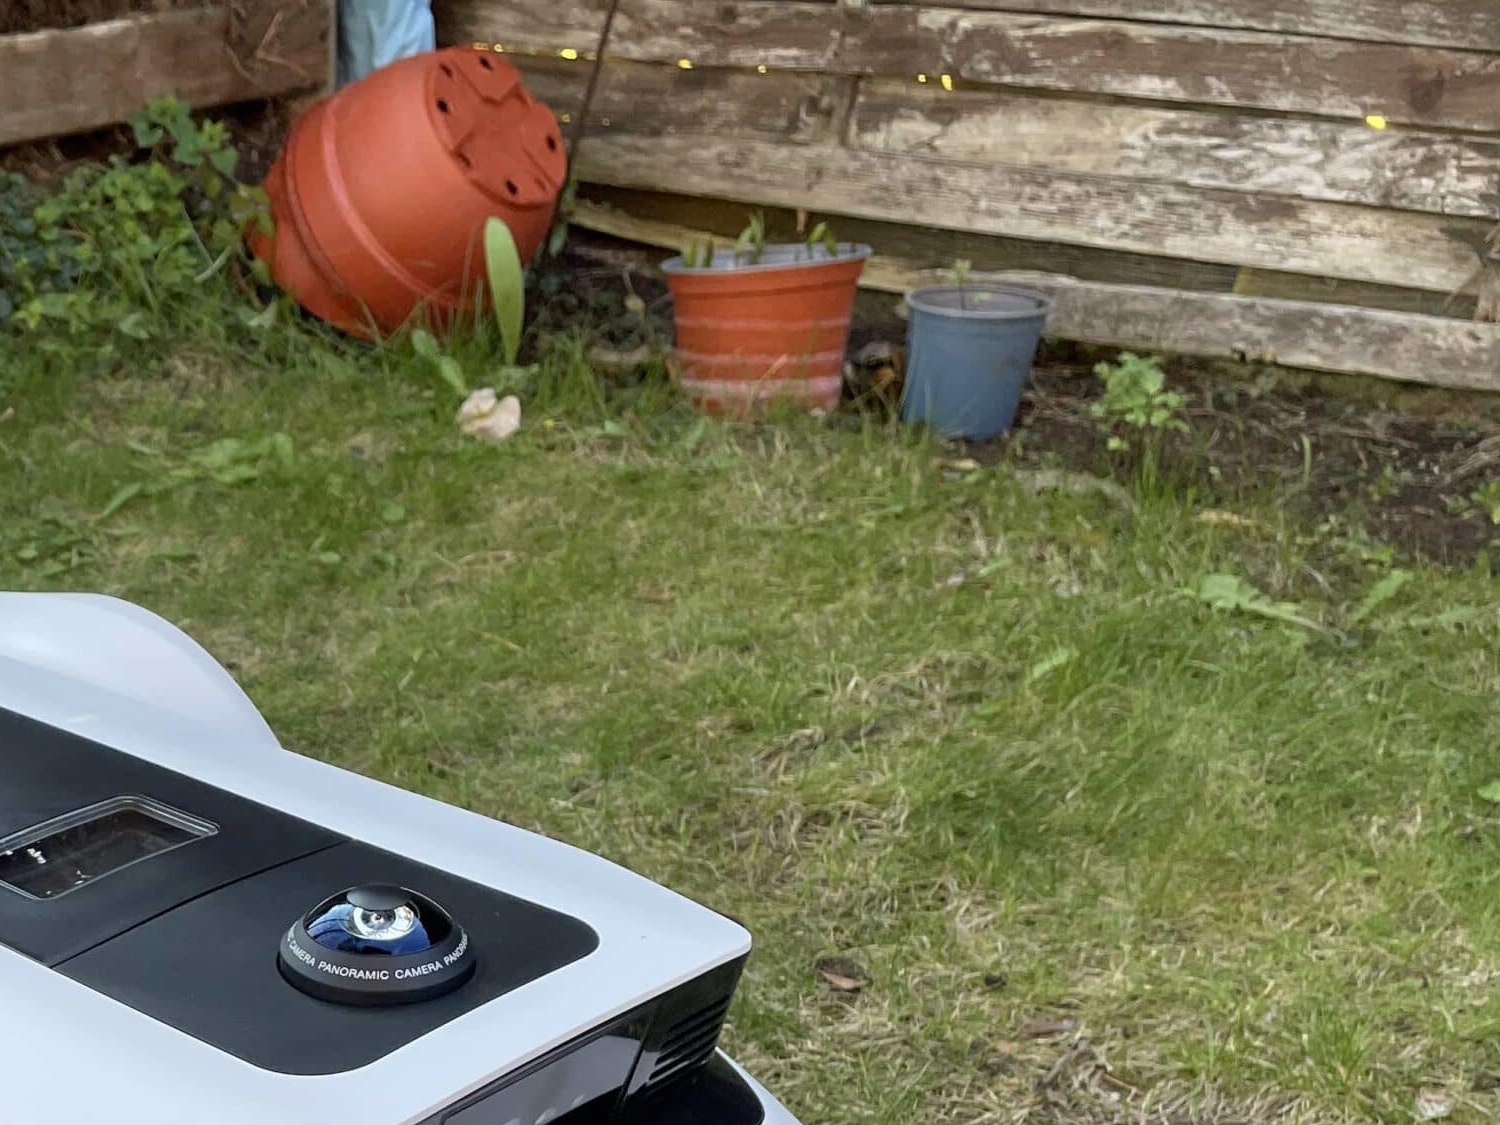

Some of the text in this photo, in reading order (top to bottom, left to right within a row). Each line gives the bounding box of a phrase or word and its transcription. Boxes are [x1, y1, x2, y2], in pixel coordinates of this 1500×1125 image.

[289, 940, 316, 967] CAMERA
[318, 960, 390, 980] PANORAMIC
[394, 961, 443, 979] CAMERA
